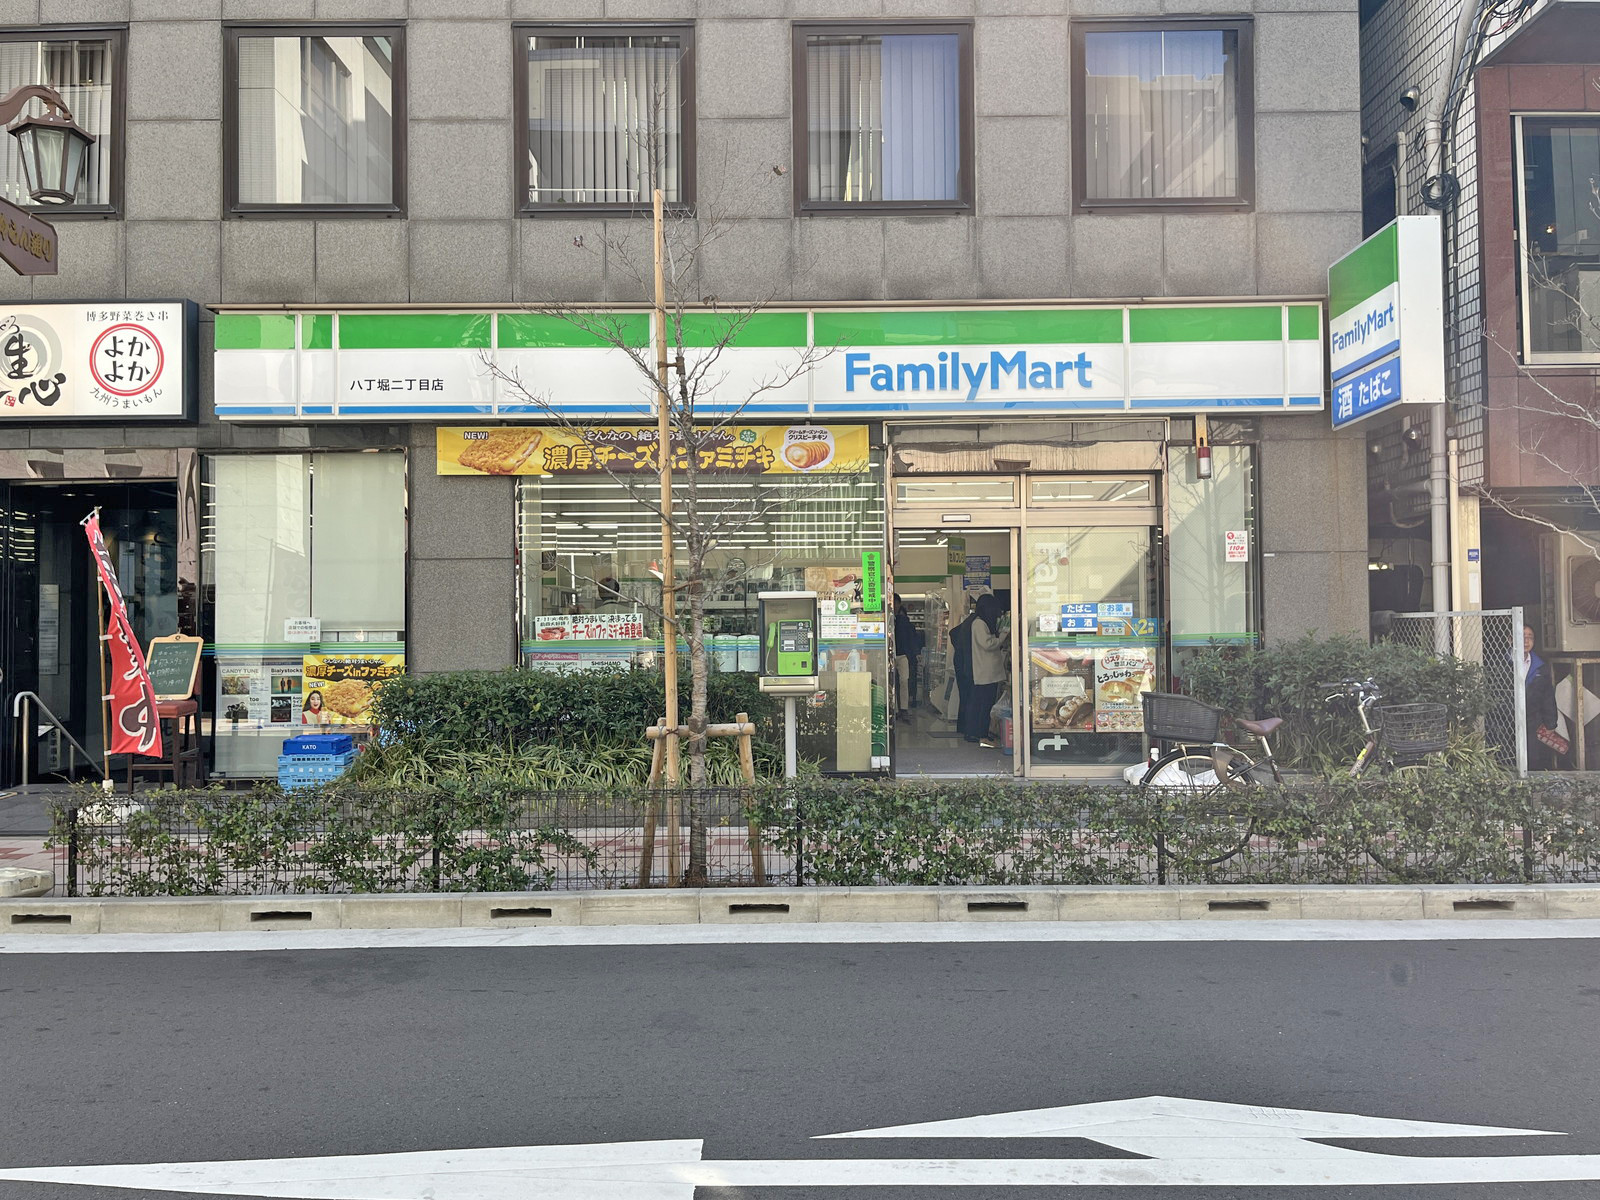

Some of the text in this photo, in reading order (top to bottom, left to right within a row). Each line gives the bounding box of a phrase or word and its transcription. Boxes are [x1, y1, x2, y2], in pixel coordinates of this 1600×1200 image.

[86, 311, 169, 322] 博多野菜巻き串
[1332, 302, 1394, 354] FamilyMart
[104, 336, 151, 357] よか
[104, 361, 151, 382] よか
[845, 351, 1092, 403] FamilyMart
[350, 379, 444, 391] 八丁堀二丁目店
[1338, 369, 1392, 419] 酒 たばこ
[90, 386, 163, 409] 九州うまいもん
[464, 431, 489, 440] NEW!
[542, 442, 776, 471] 濃厚チーズァミチキ
[1067, 605, 1092, 613] たばこ
[308, 681, 326, 689] NEW!
